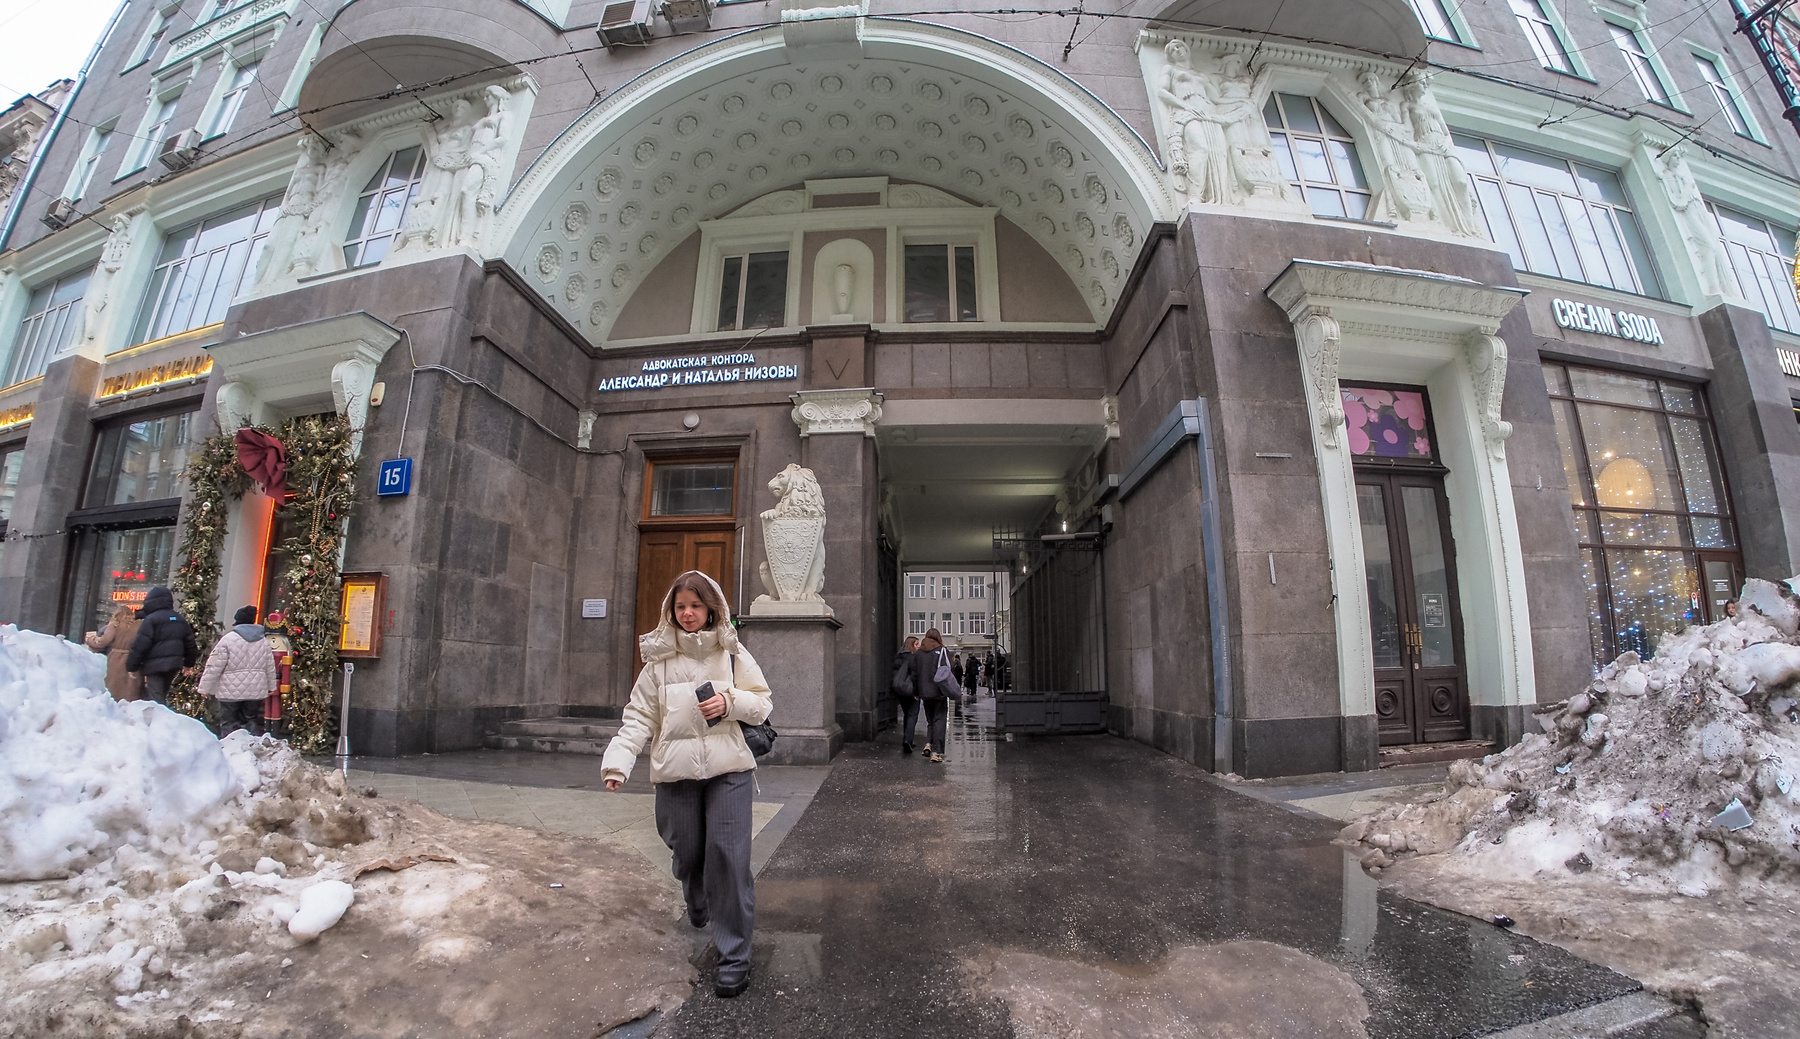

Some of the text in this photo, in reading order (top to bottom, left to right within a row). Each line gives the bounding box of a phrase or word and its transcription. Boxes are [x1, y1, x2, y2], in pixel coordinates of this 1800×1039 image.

[1551, 298, 1665, 345] CREAM SODA
[642, 353, 755, 371] АДВОКАТСКАЯ КОНТОРА
[598, 365, 798, 391] АЛЕКСАНДР И НАТАЛЬЯ НИЗОВЫ
[384, 467, 402, 486] 15
[136, 591, 148, 601] HE
